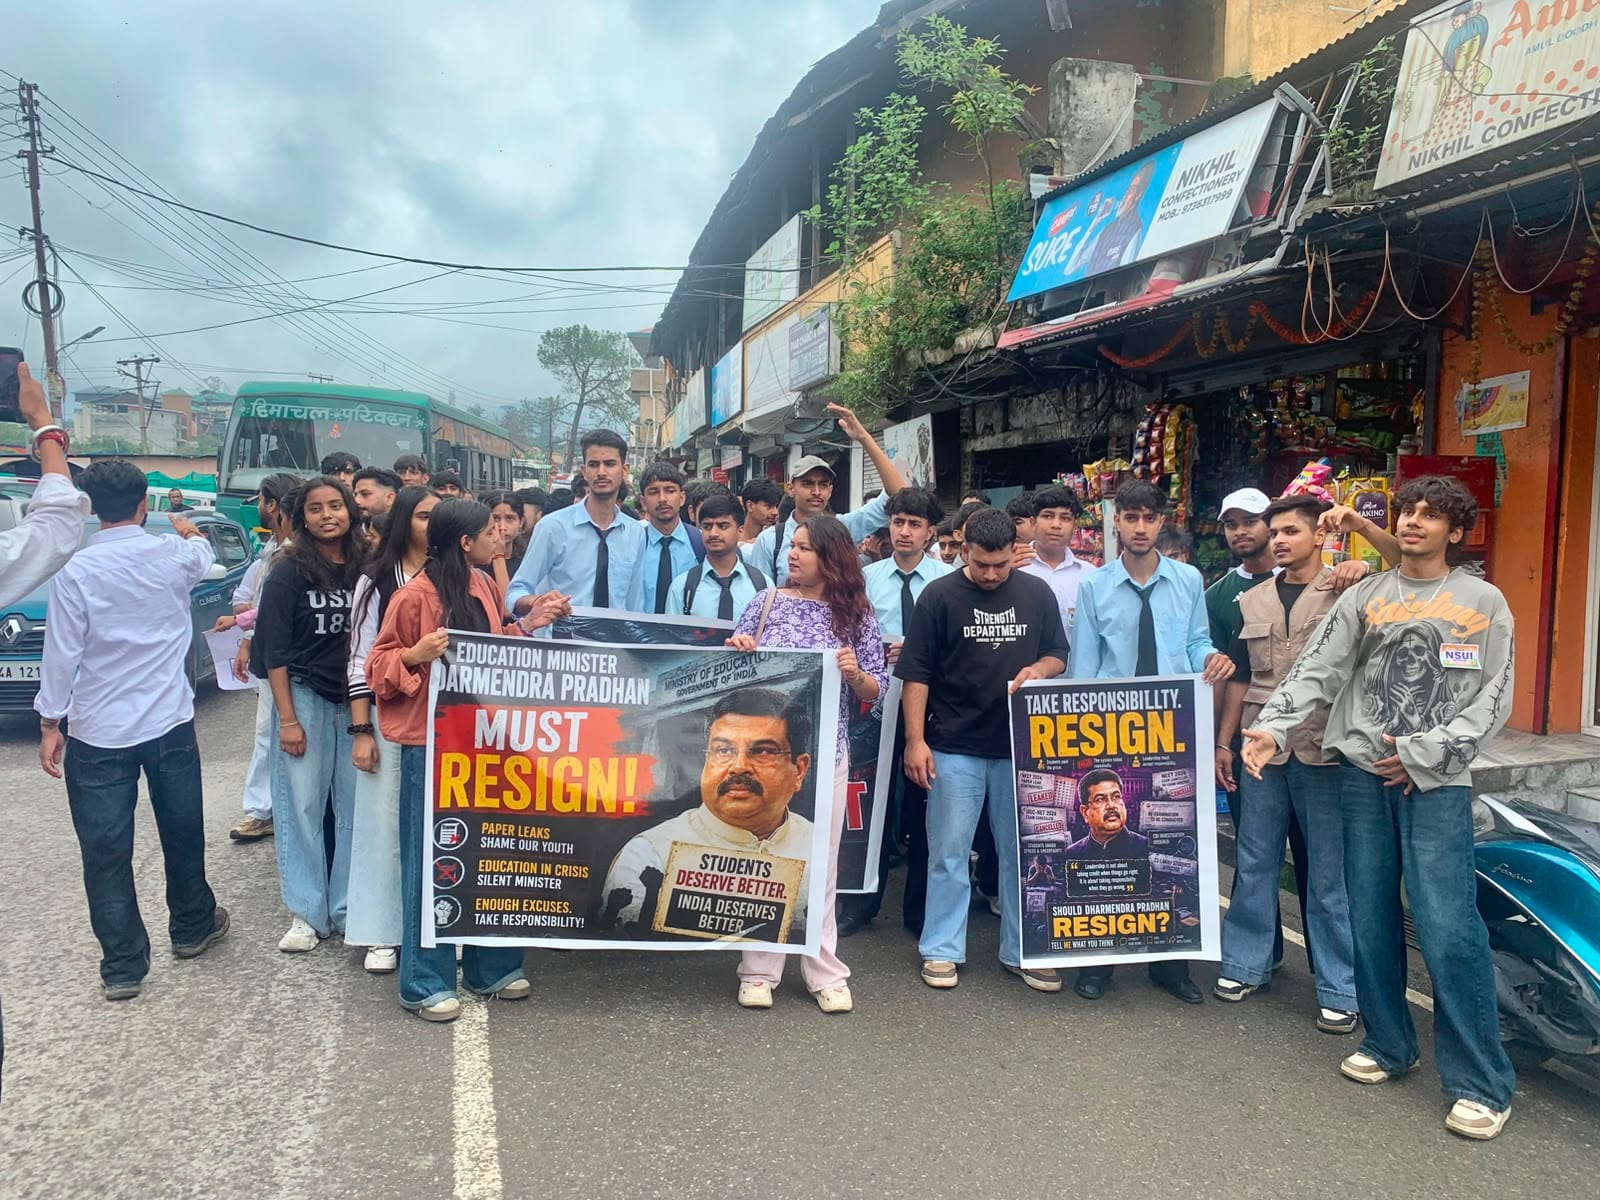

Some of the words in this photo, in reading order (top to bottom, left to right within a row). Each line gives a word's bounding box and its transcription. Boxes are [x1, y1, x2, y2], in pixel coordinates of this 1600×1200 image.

[1407, 135, 1475, 171] NIKHIL
[1176, 150, 1236, 190] NIKHIL
[1161, 168, 1245, 208] CONFECTIONERY
[1022, 226, 1082, 276] SURE
[250, 398, 332, 421] हिमाचल
[343, 404, 412, 427] परिवहन
[973, 606, 1016, 625] STRENGTH
[963, 624, 1028, 638] DEPARTMENT
[456, 641, 543, 668] EDUCATION
[547, 650, 618, 674] MINISTER
[1446, 651, 1473, 660] NSUI
[676, 679, 719, 697] GOVERNMENT
[721, 674, 731, 684] OF
[734, 667, 757, 681] INDIA
[700, 667, 711, 680] OF
[561, 674, 650, 705] PRADHAN
[1025, 694, 1058, 714] TAKE
[474, 709, 588, 752] MUST
[1029, 711, 1186, 758] RESIGN.
[439, 753, 638, 813] RESIGN!
[1030, 791, 1054, 802] LEAKED
[481, 822, 515, 836] PAPER
[518, 825, 551, 839] LEAKS
[1035, 821, 1063, 832] CANCELLED
[480, 836, 516, 849] SHAME
[519, 839, 539, 851] OUR
[541, 841, 574, 854] YOUTH
[478, 860, 537, 874] EDUCATION
[541, 864, 551, 875] IN
[555, 865, 589, 878] CRISIS
[699, 853, 772, 878] STUDENTS
[477, 874, 512, 887] SILENT
[514, 876, 562, 889] MINISTER
[676, 869, 736, 892] DESERVE
[737, 877, 787, 899] BETTER.
[475, 898, 519, 911] ENOUGH
[522, 899, 572, 914] EXCUSES.
[677, 893, 712, 912] INDIA
[715, 899, 777, 920] DESERVES
[1052, 905, 1082, 916] SHOULD
[1085, 903, 1135, 915] DHARMENDRA
[1136, 901, 1170, 912] PRADHAN
[474, 913, 499, 925] TAKE
[502, 914, 585, 928] RESPONSIBILITY!
[1053, 912, 1170, 938] RESIGN?
[1072, 940, 1086, 948] WHAT
[1099, 939, 1114, 947] THINK
